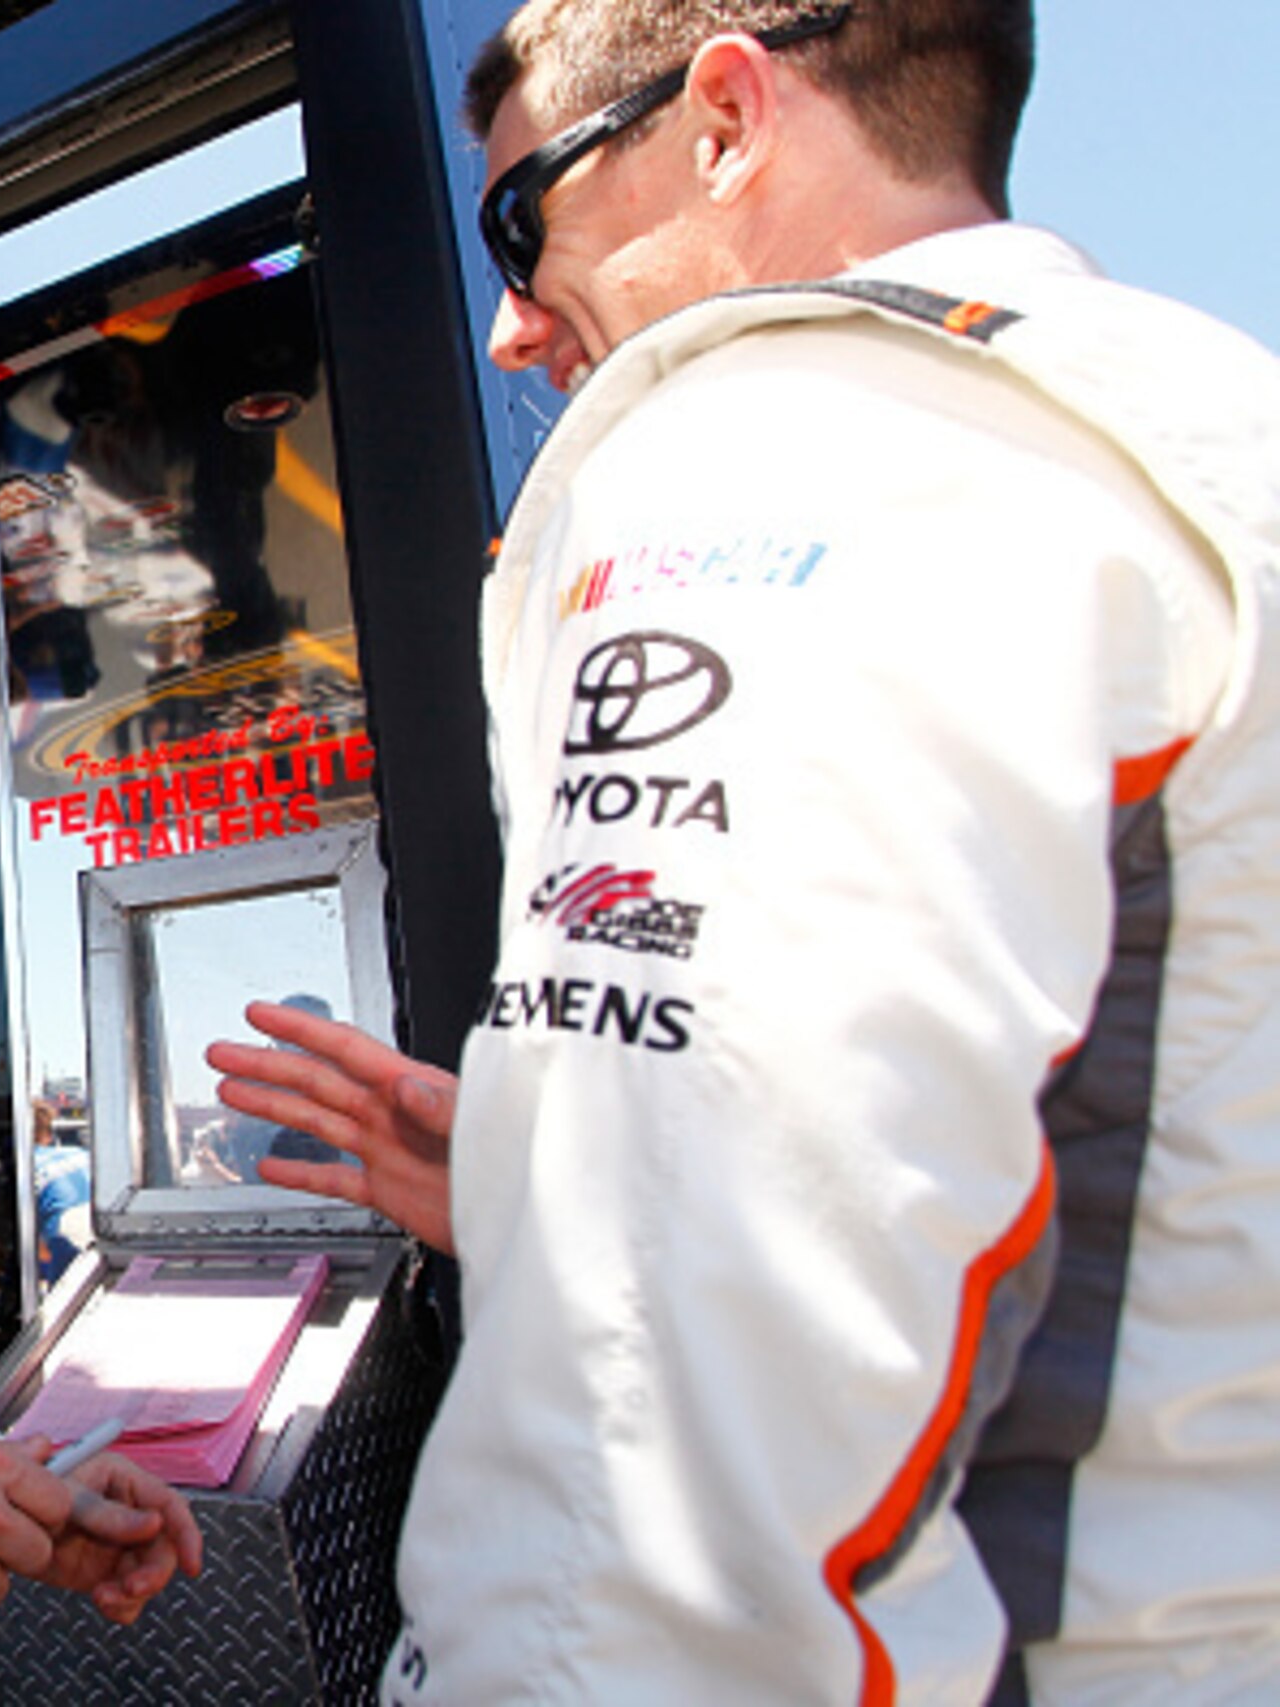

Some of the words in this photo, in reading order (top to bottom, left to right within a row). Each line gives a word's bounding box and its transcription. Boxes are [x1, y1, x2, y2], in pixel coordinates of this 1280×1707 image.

[29, 734, 376, 842] FEATHERLITE
[64, 716, 252, 786] Transported
[83, 793, 321, 868] TRAILERS
